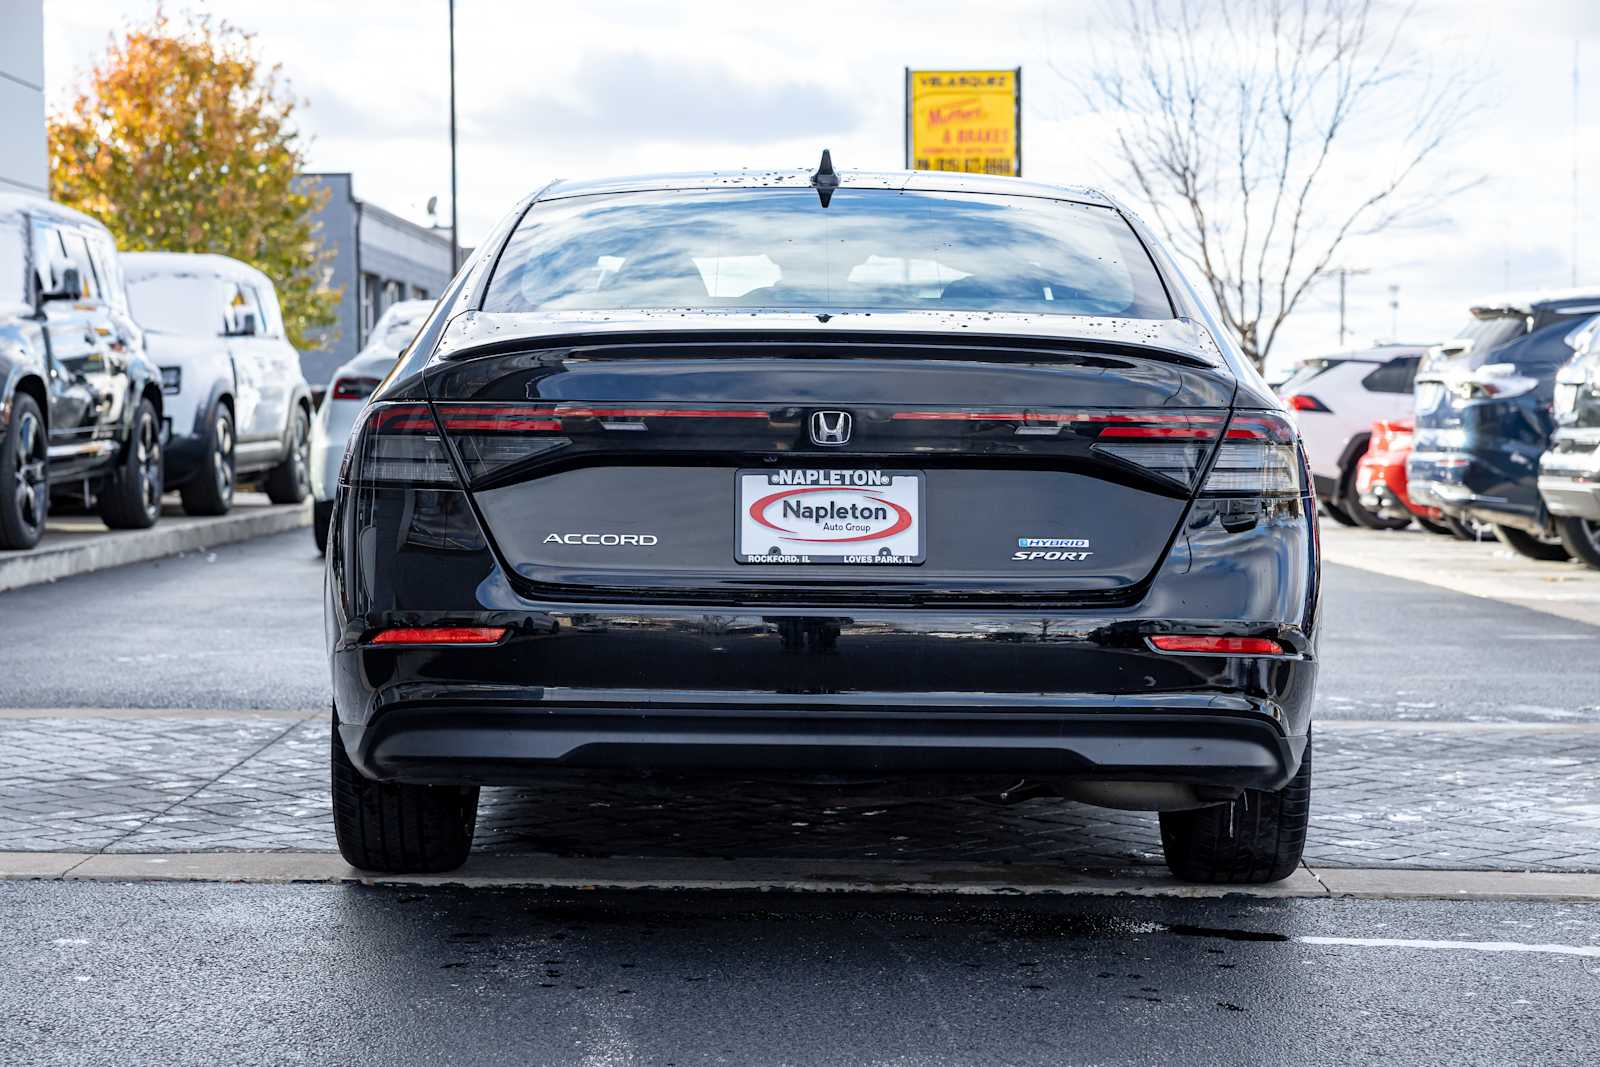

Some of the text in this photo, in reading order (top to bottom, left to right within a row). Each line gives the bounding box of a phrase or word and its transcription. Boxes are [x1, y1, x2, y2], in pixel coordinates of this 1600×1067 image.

[779, 469, 881, 485] NAPLETON
[783, 500, 887, 523] Napleton
[823, 522, 871, 533] Auto Group
[543, 533, 658, 546] ACCORD
[748, 555, 811, 563] ROCKFORD, IL
[843, 555, 913, 564] LOVES PARK, IL
[1011, 551, 1094, 561] SPORT
